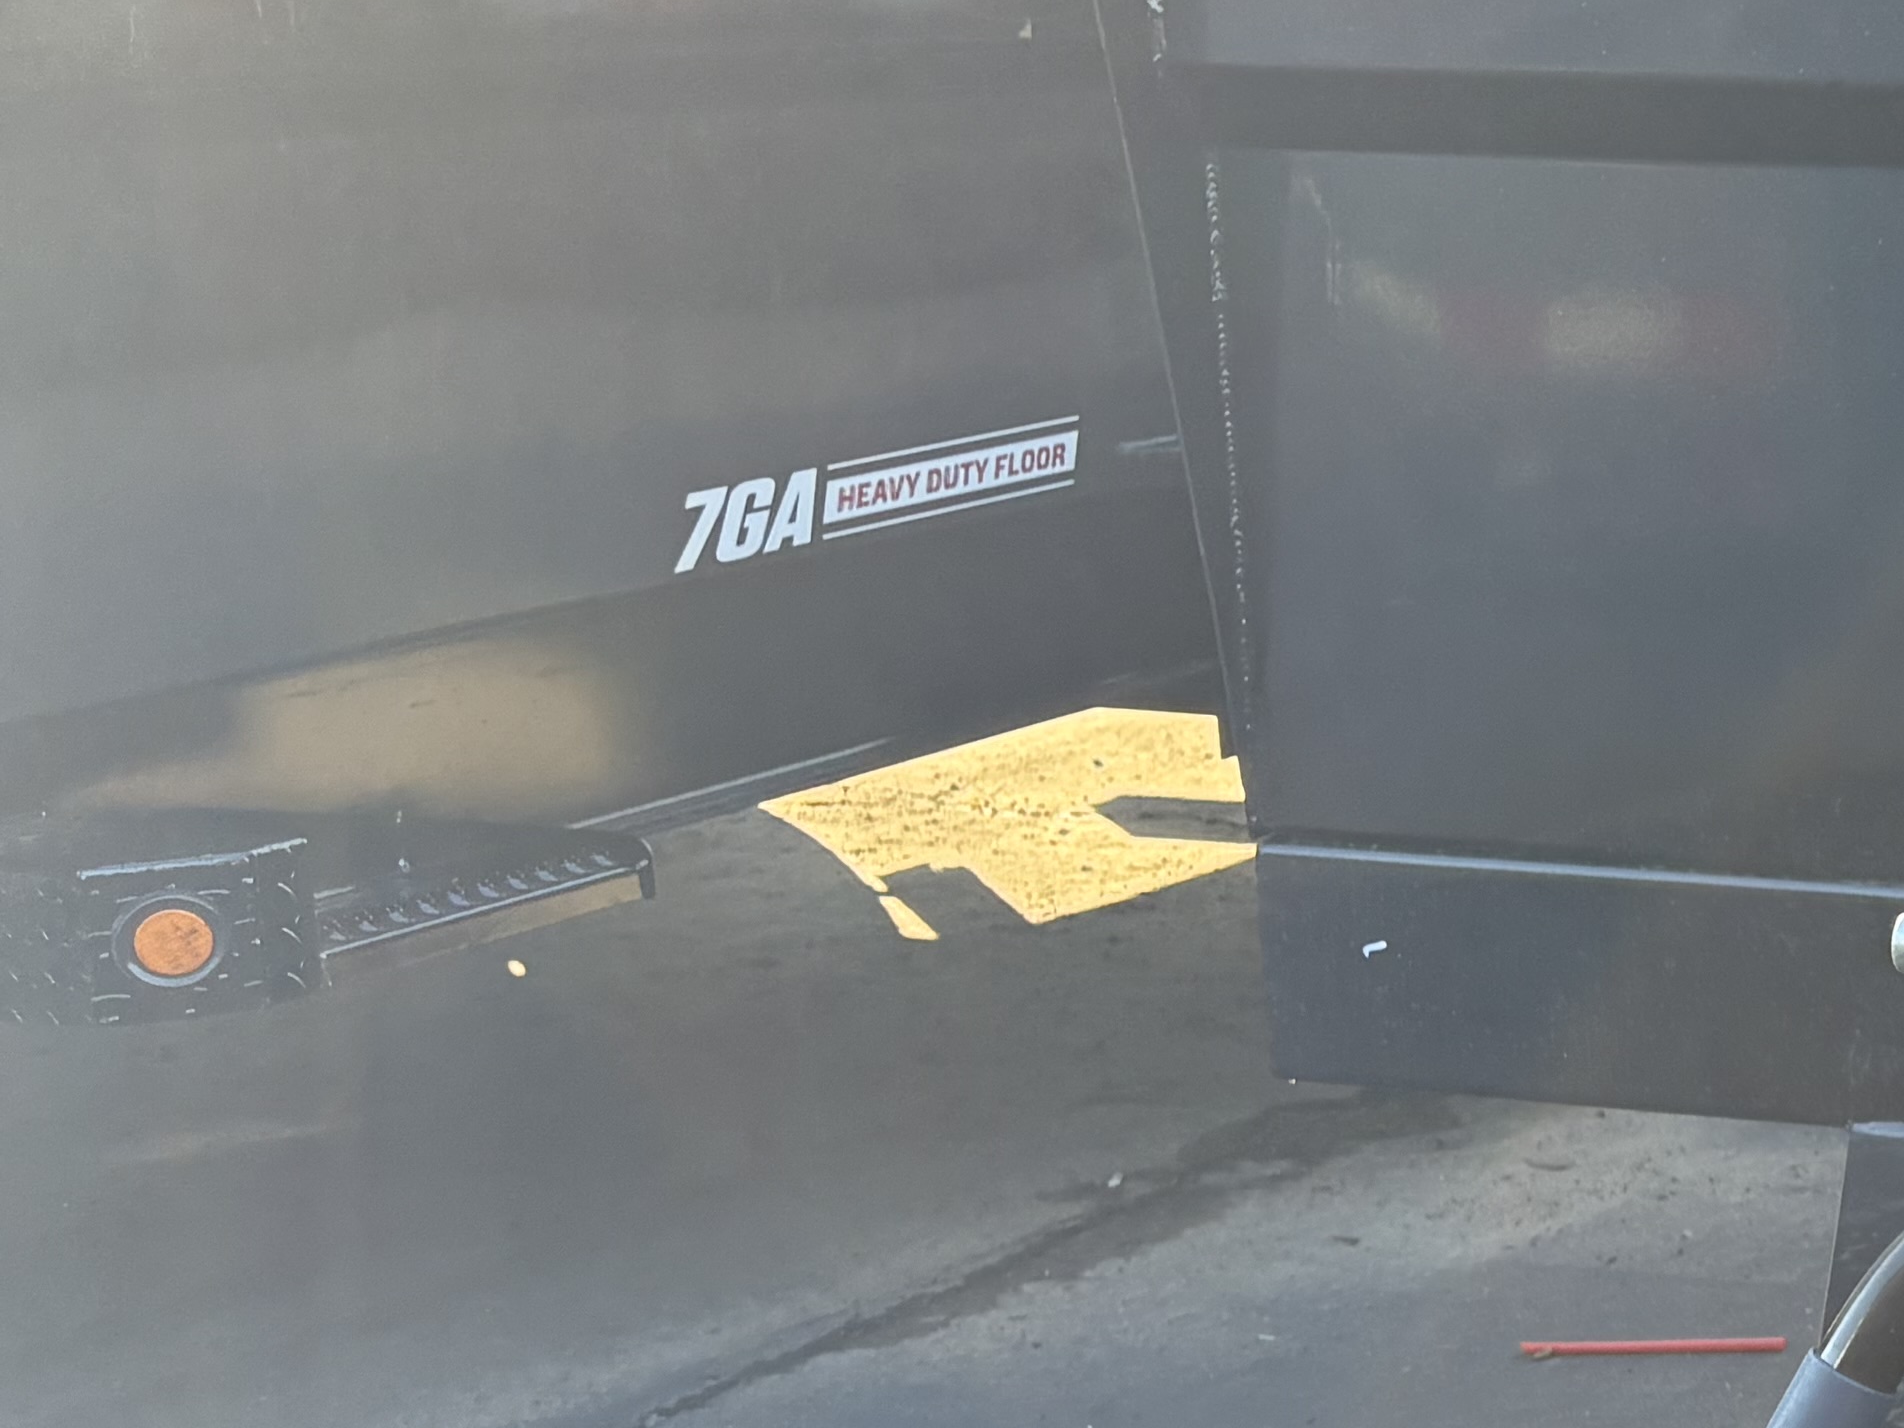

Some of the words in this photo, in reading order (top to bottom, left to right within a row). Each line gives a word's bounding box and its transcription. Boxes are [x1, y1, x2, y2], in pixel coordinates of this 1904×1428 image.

[674, 467, 818, 574] 7GA
[837, 469, 921, 513] HEAVY
[926, 458, 990, 494] DUTY
[994, 442, 1066, 480] FLOOR
